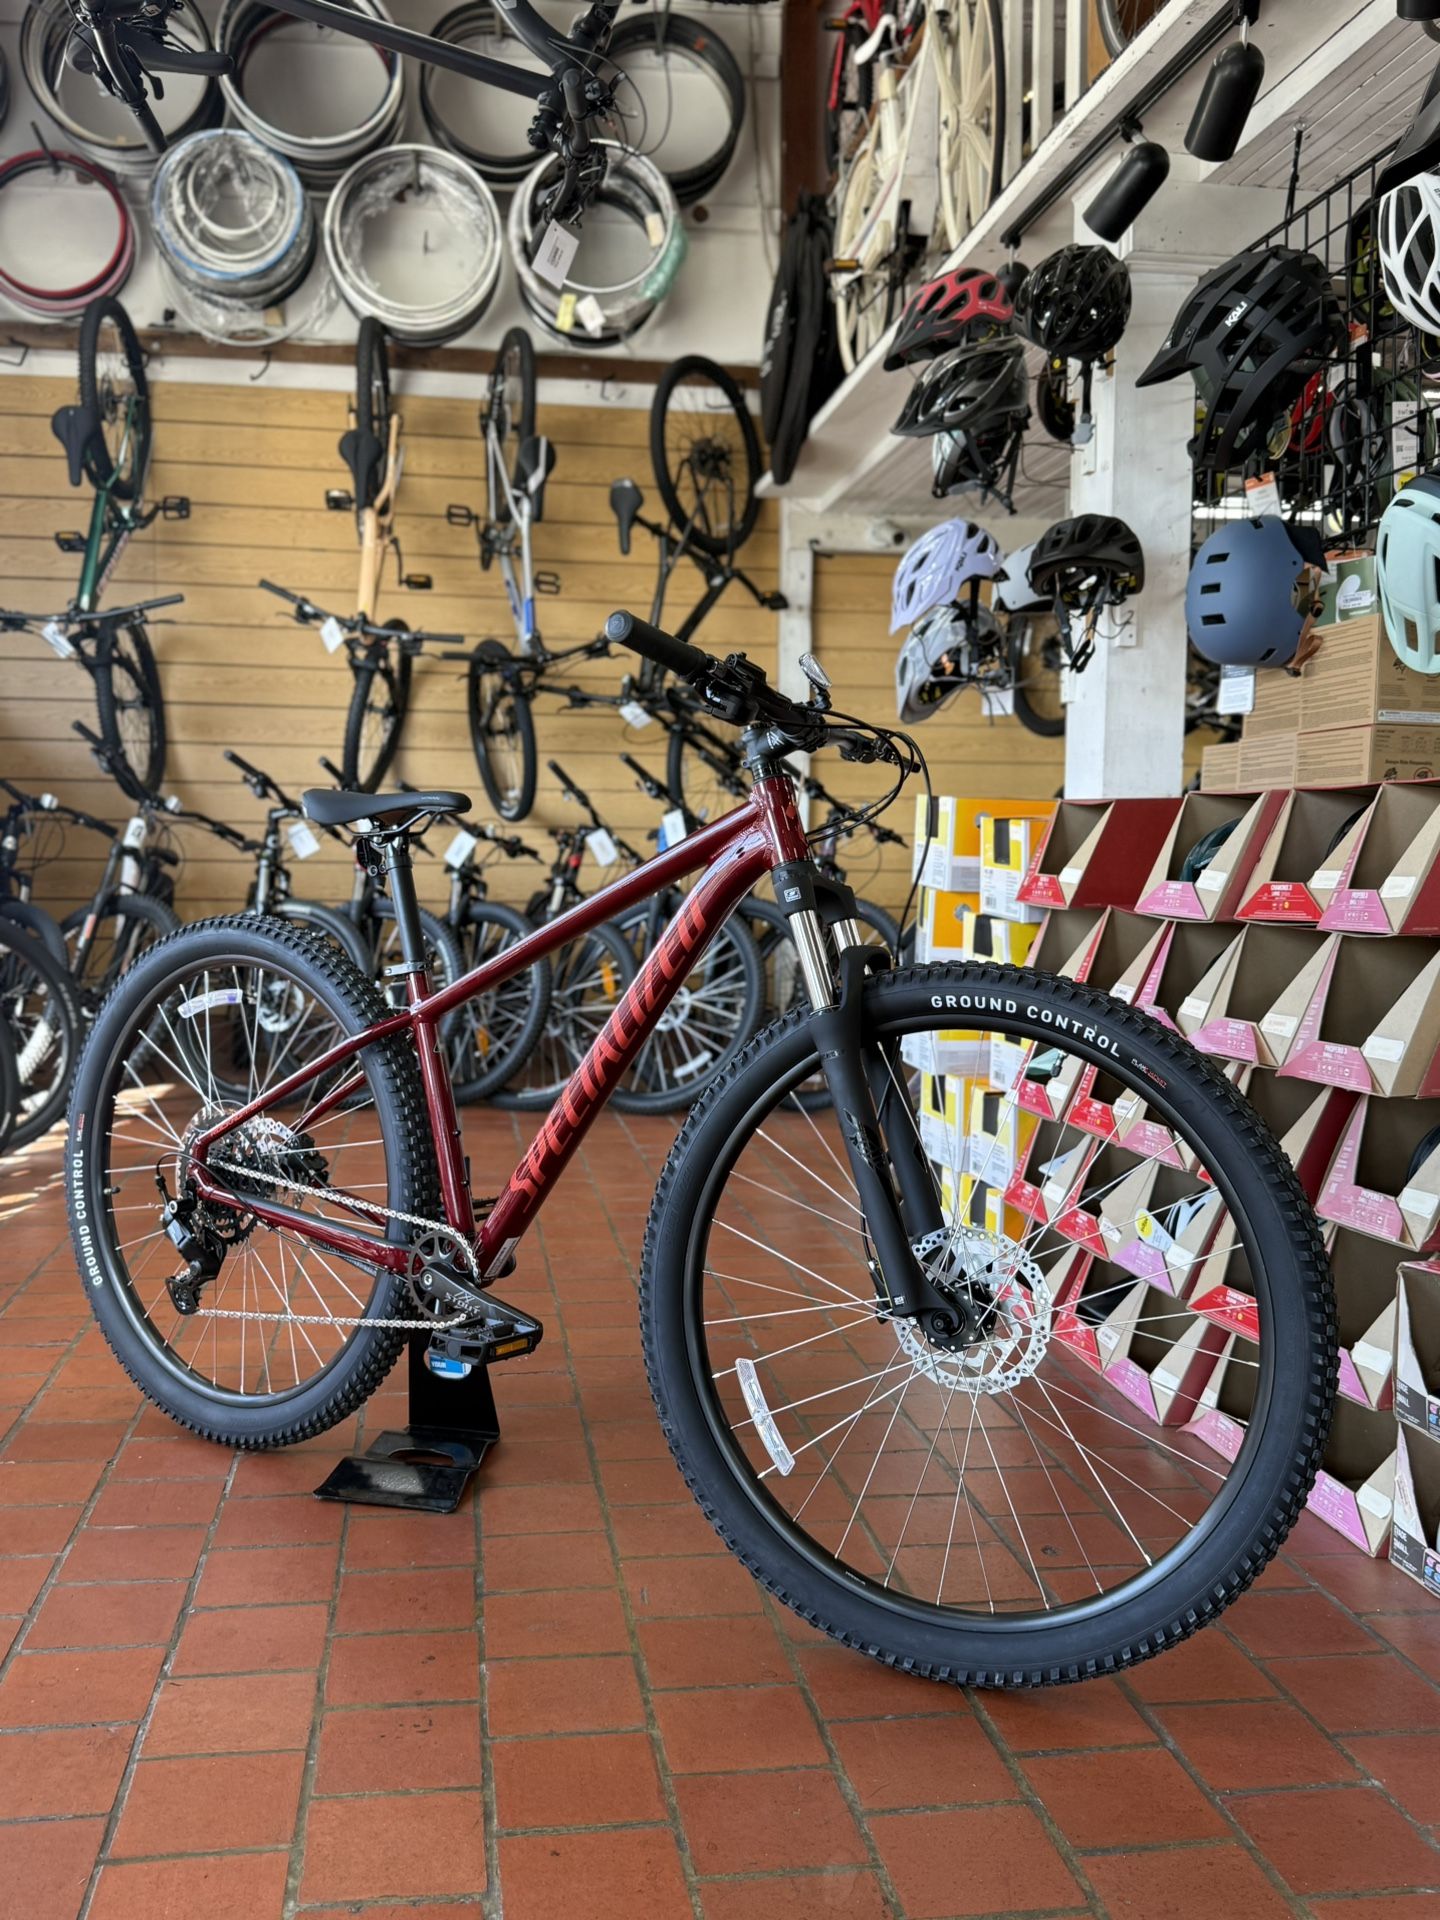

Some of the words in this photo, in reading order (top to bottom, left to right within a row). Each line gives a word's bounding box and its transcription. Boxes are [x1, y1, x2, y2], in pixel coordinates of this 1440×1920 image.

[1225, 301, 1248, 327] KALI
[510, 898, 706, 1212] SPECIALIZED
[930, 994, 1018, 1014] GROUND
[1026, 1005, 1121, 1058] CONTROL
[73, 1149, 87, 1220] CONTROL
[79, 1225, 103, 1287] GROUND
[443, 1291, 481, 1315] STOUT
